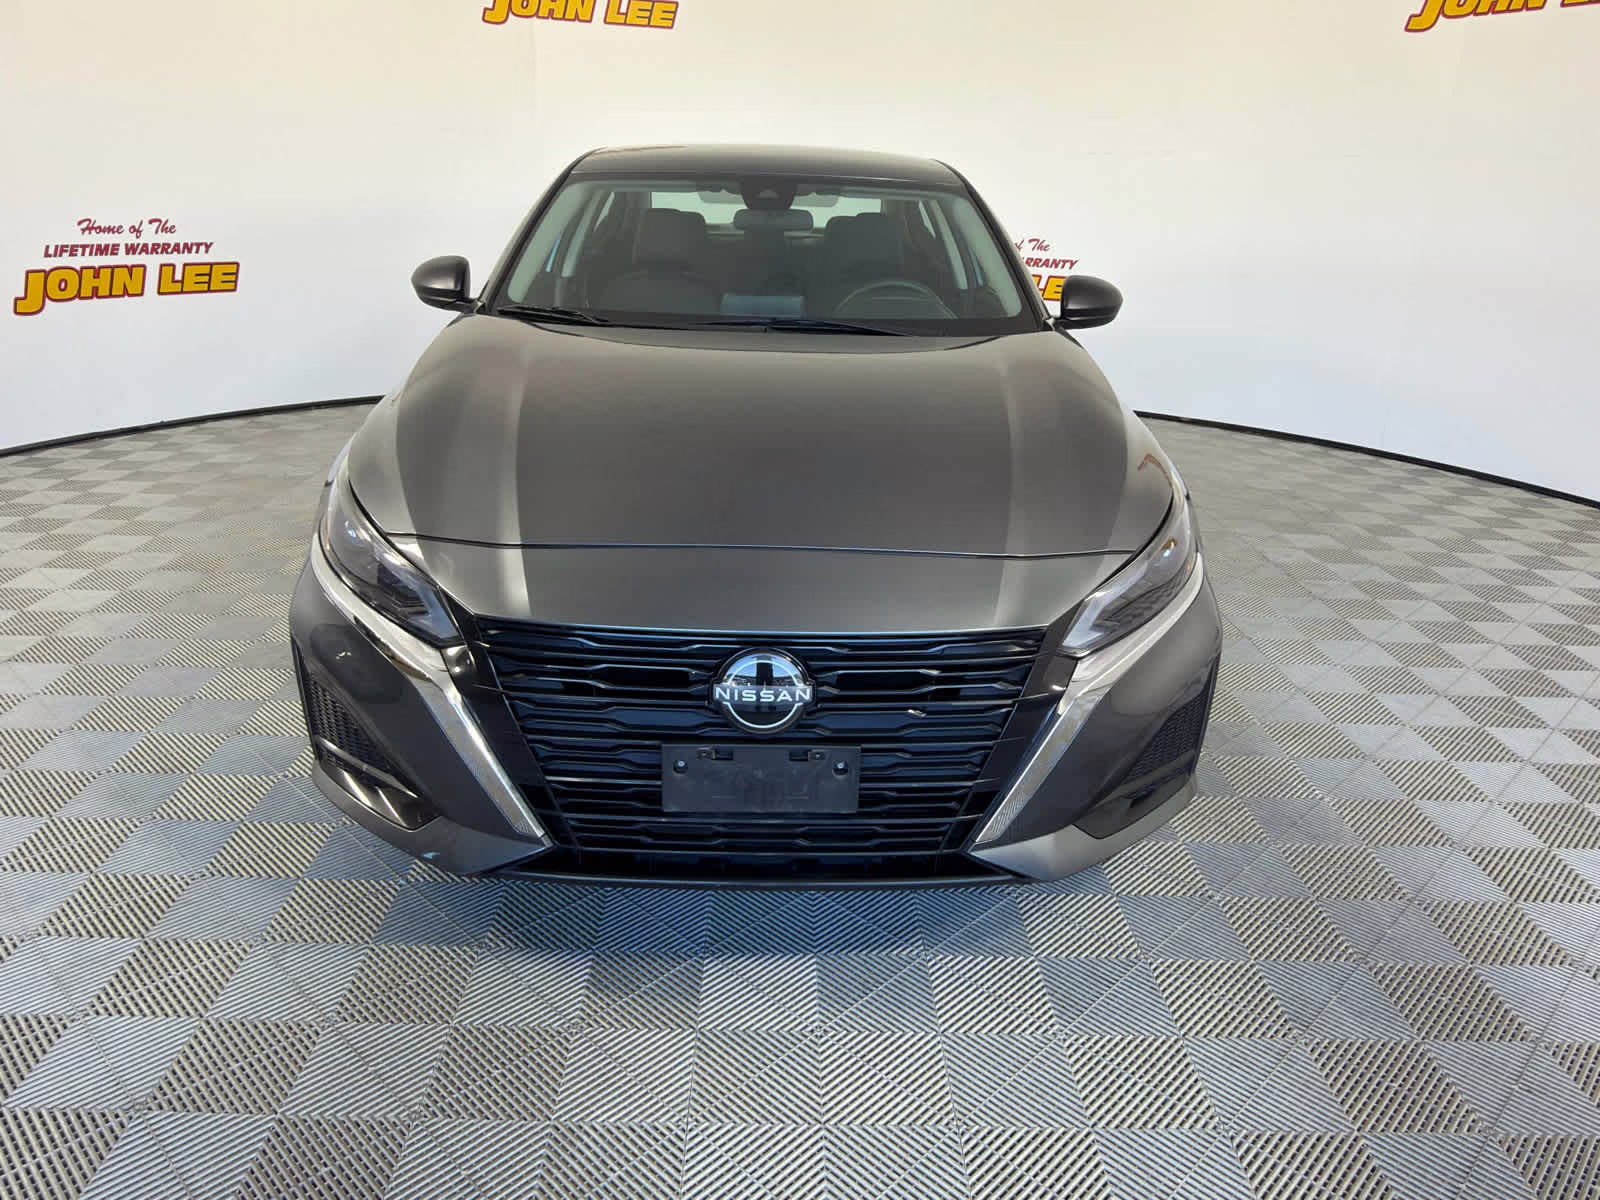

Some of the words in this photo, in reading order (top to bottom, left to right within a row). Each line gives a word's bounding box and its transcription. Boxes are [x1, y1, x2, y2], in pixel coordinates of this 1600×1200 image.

[482, 0, 595, 25] JOHN
[604, 0, 679, 29] LEE
[77, 218, 125, 235] Home
[129, 220, 143, 239] of
[148, 218, 176, 235] The
[44, 243, 120, 258] LIFETIME
[124, 242, 214, 256] WARRANTY
[1028, 238, 1050, 251] The
[1024, 257, 1079, 270] RRANTY
[13, 264, 147, 316] JOHN
[157, 262, 240, 295] LEE
[715, 687, 811, 702] NISSAN
